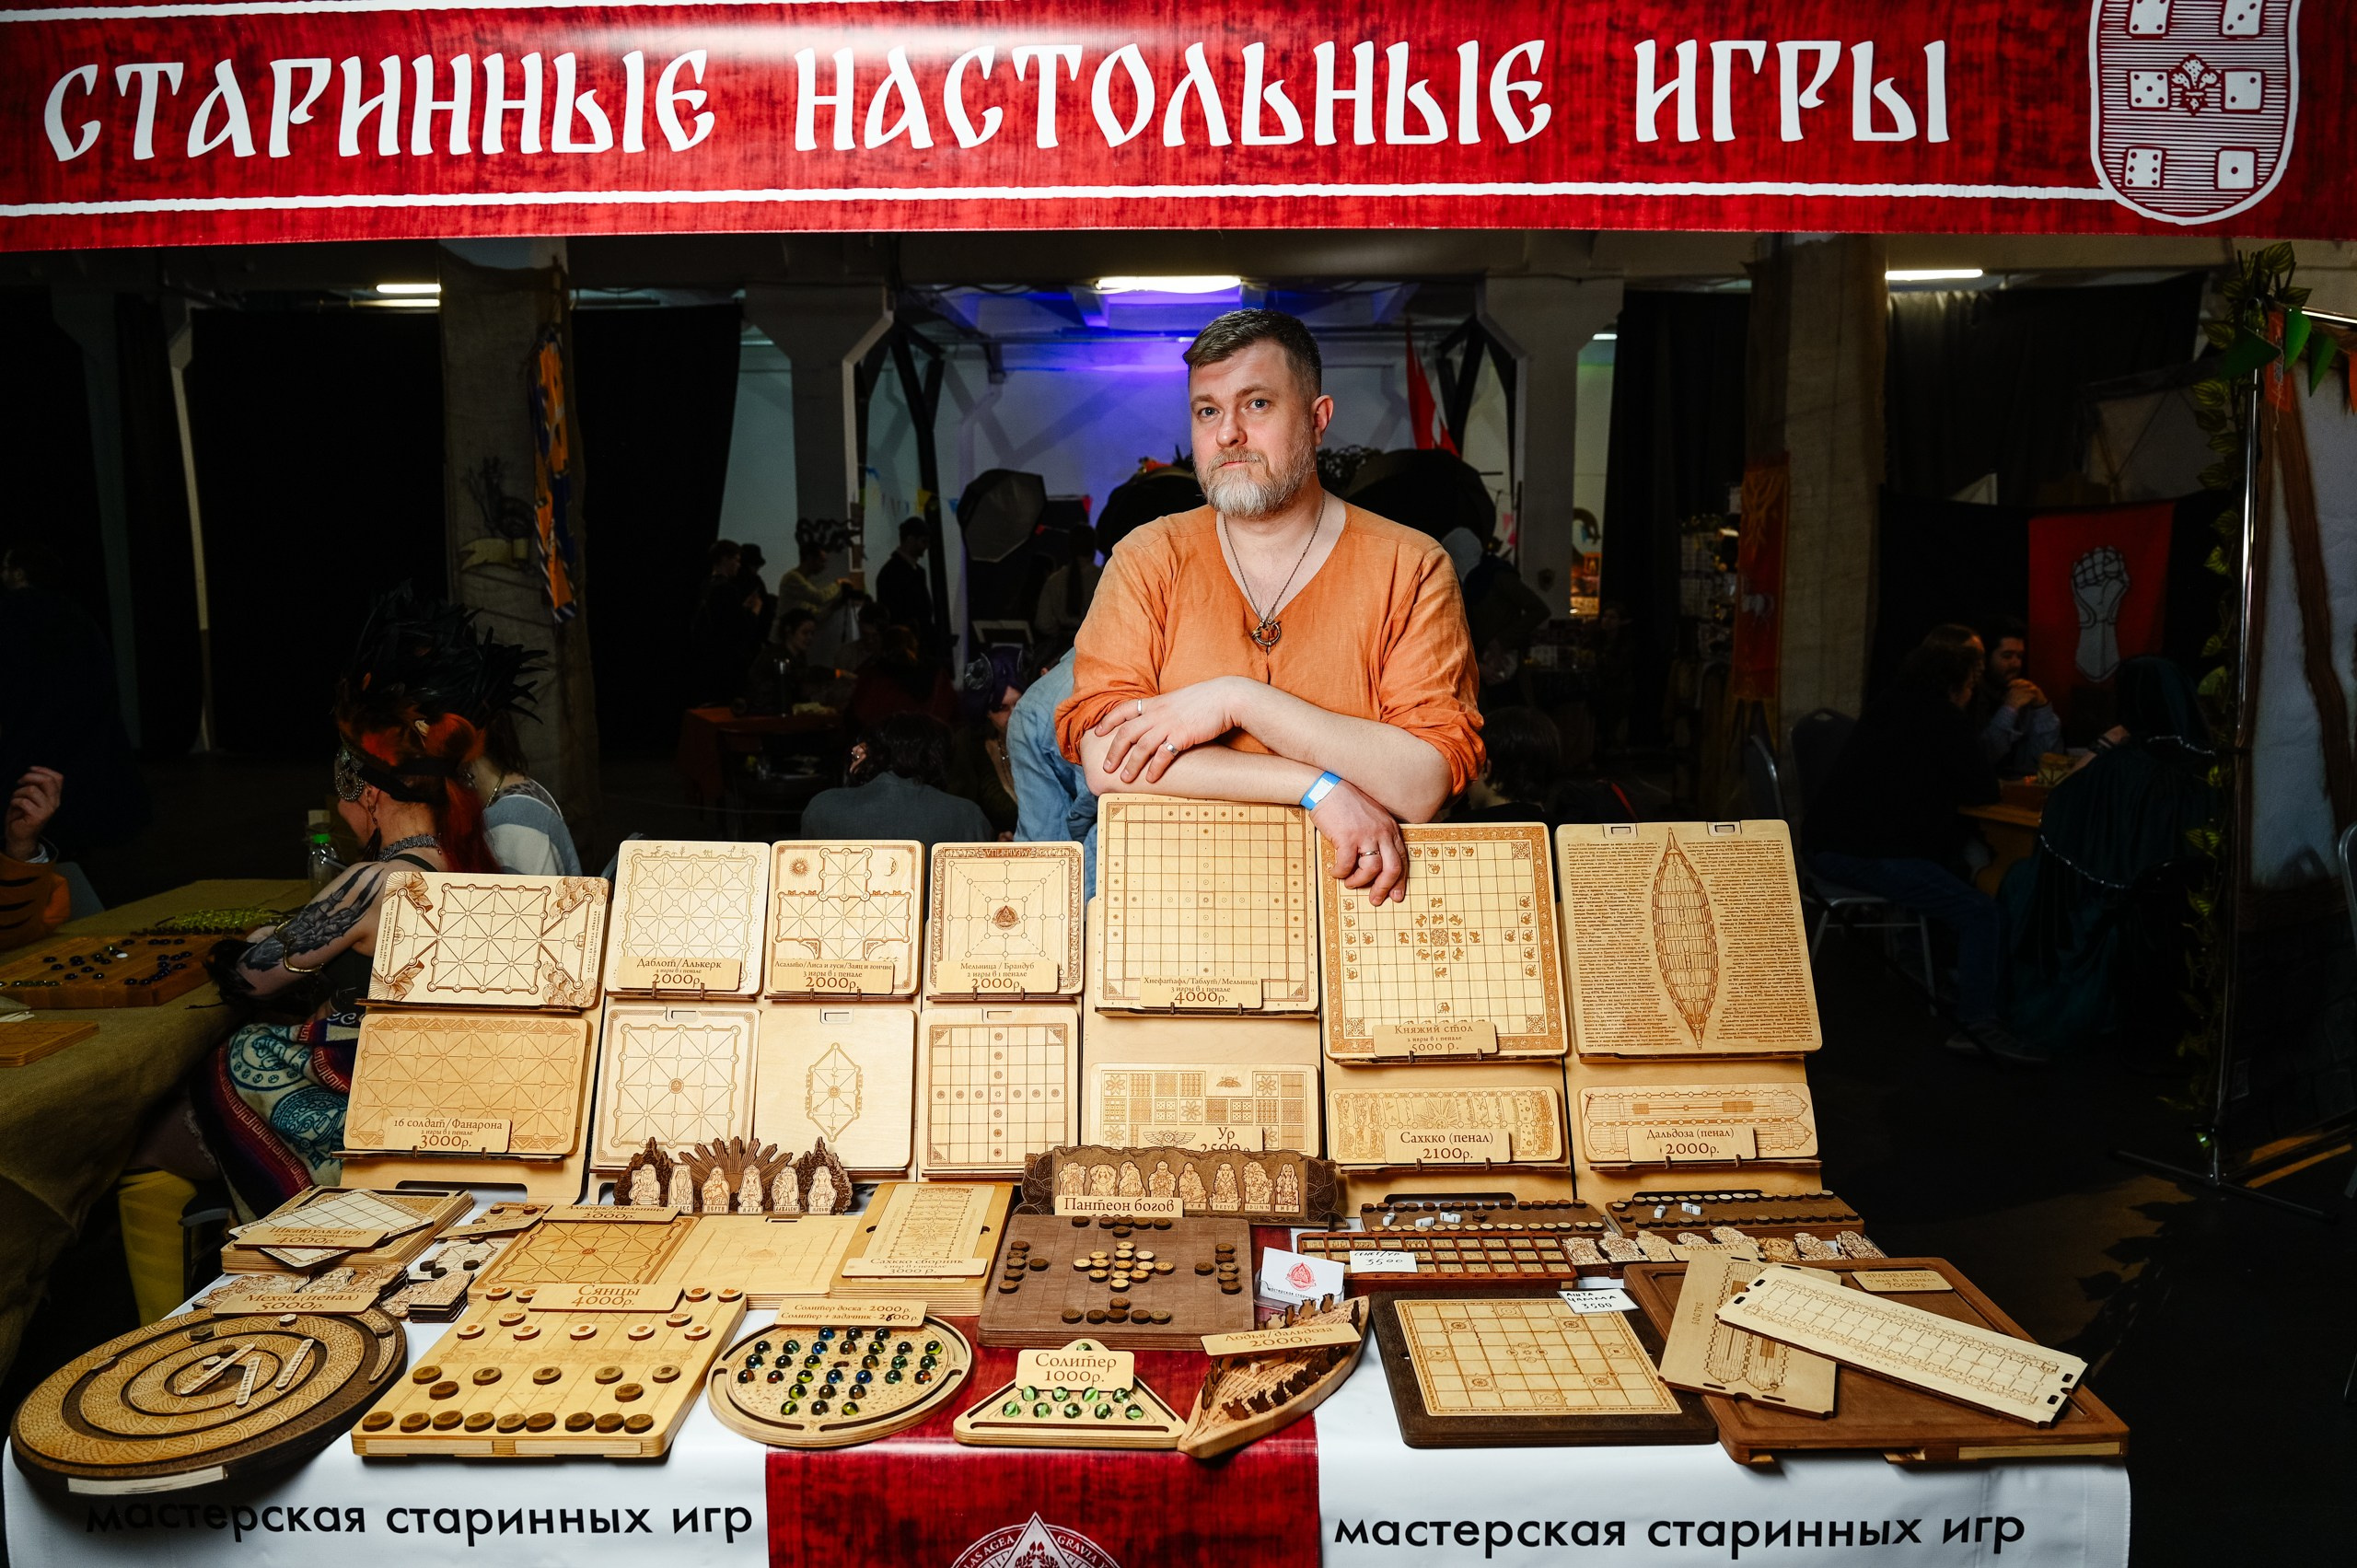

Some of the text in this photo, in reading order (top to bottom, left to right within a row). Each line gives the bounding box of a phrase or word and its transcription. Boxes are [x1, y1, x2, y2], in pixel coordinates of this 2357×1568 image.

[44, 39, 1951, 163] СТАРИННЫЕ НАСТОЛЬНЫЕ ИГРЫ
[960, 962, 997, 970] Мельница
[1004, 961, 1035, 972] Брандуб
[805, 976, 860, 993] 2000р.
[1174, 991, 1228, 1005] 4000р.
[1394, 1025, 1440, 1035] Княжий
[1411, 1042, 1443, 1053] 5000
[394, 1117, 503, 1132] 16 солдат/Фанарона
[1217, 1126, 1236, 1144] Ур
[1399, 1131, 1493, 1144] Сахкко (пенал)
[1646, 1127, 1735, 1141] Дальдоза (пенал)
[419, 1135, 472, 1151] 3000р.
[1422, 1147, 1473, 1164] 2100р.
[1666, 1143, 1720, 1158] 2000р.
[1063, 1197, 1175, 1213] Пантеон богов
[275, 1237, 336, 1246] 4000р.
[243, 1294, 359, 1302] Мехен (пенал)
[578, 1284, 641, 1298] Сянцы
[256, 1301, 325, 1312] 5000р.
[571, 1295, 634, 1307] 4000р.
[795, 1304, 835, 1312] Солитер
[781, 1312, 822, 1320] Солитер
[831, 1312, 872, 1320] задачник
[1249, 1335, 1317, 1348] 2000р.
[1035, 1353, 1117, 1373] Солитер
[1044, 1370, 1105, 1388] 1000р.
[85, 1503, 754, 1547] мастерская старинных игр
[1334, 1516, 2026, 1561] мастерская старинных игр
